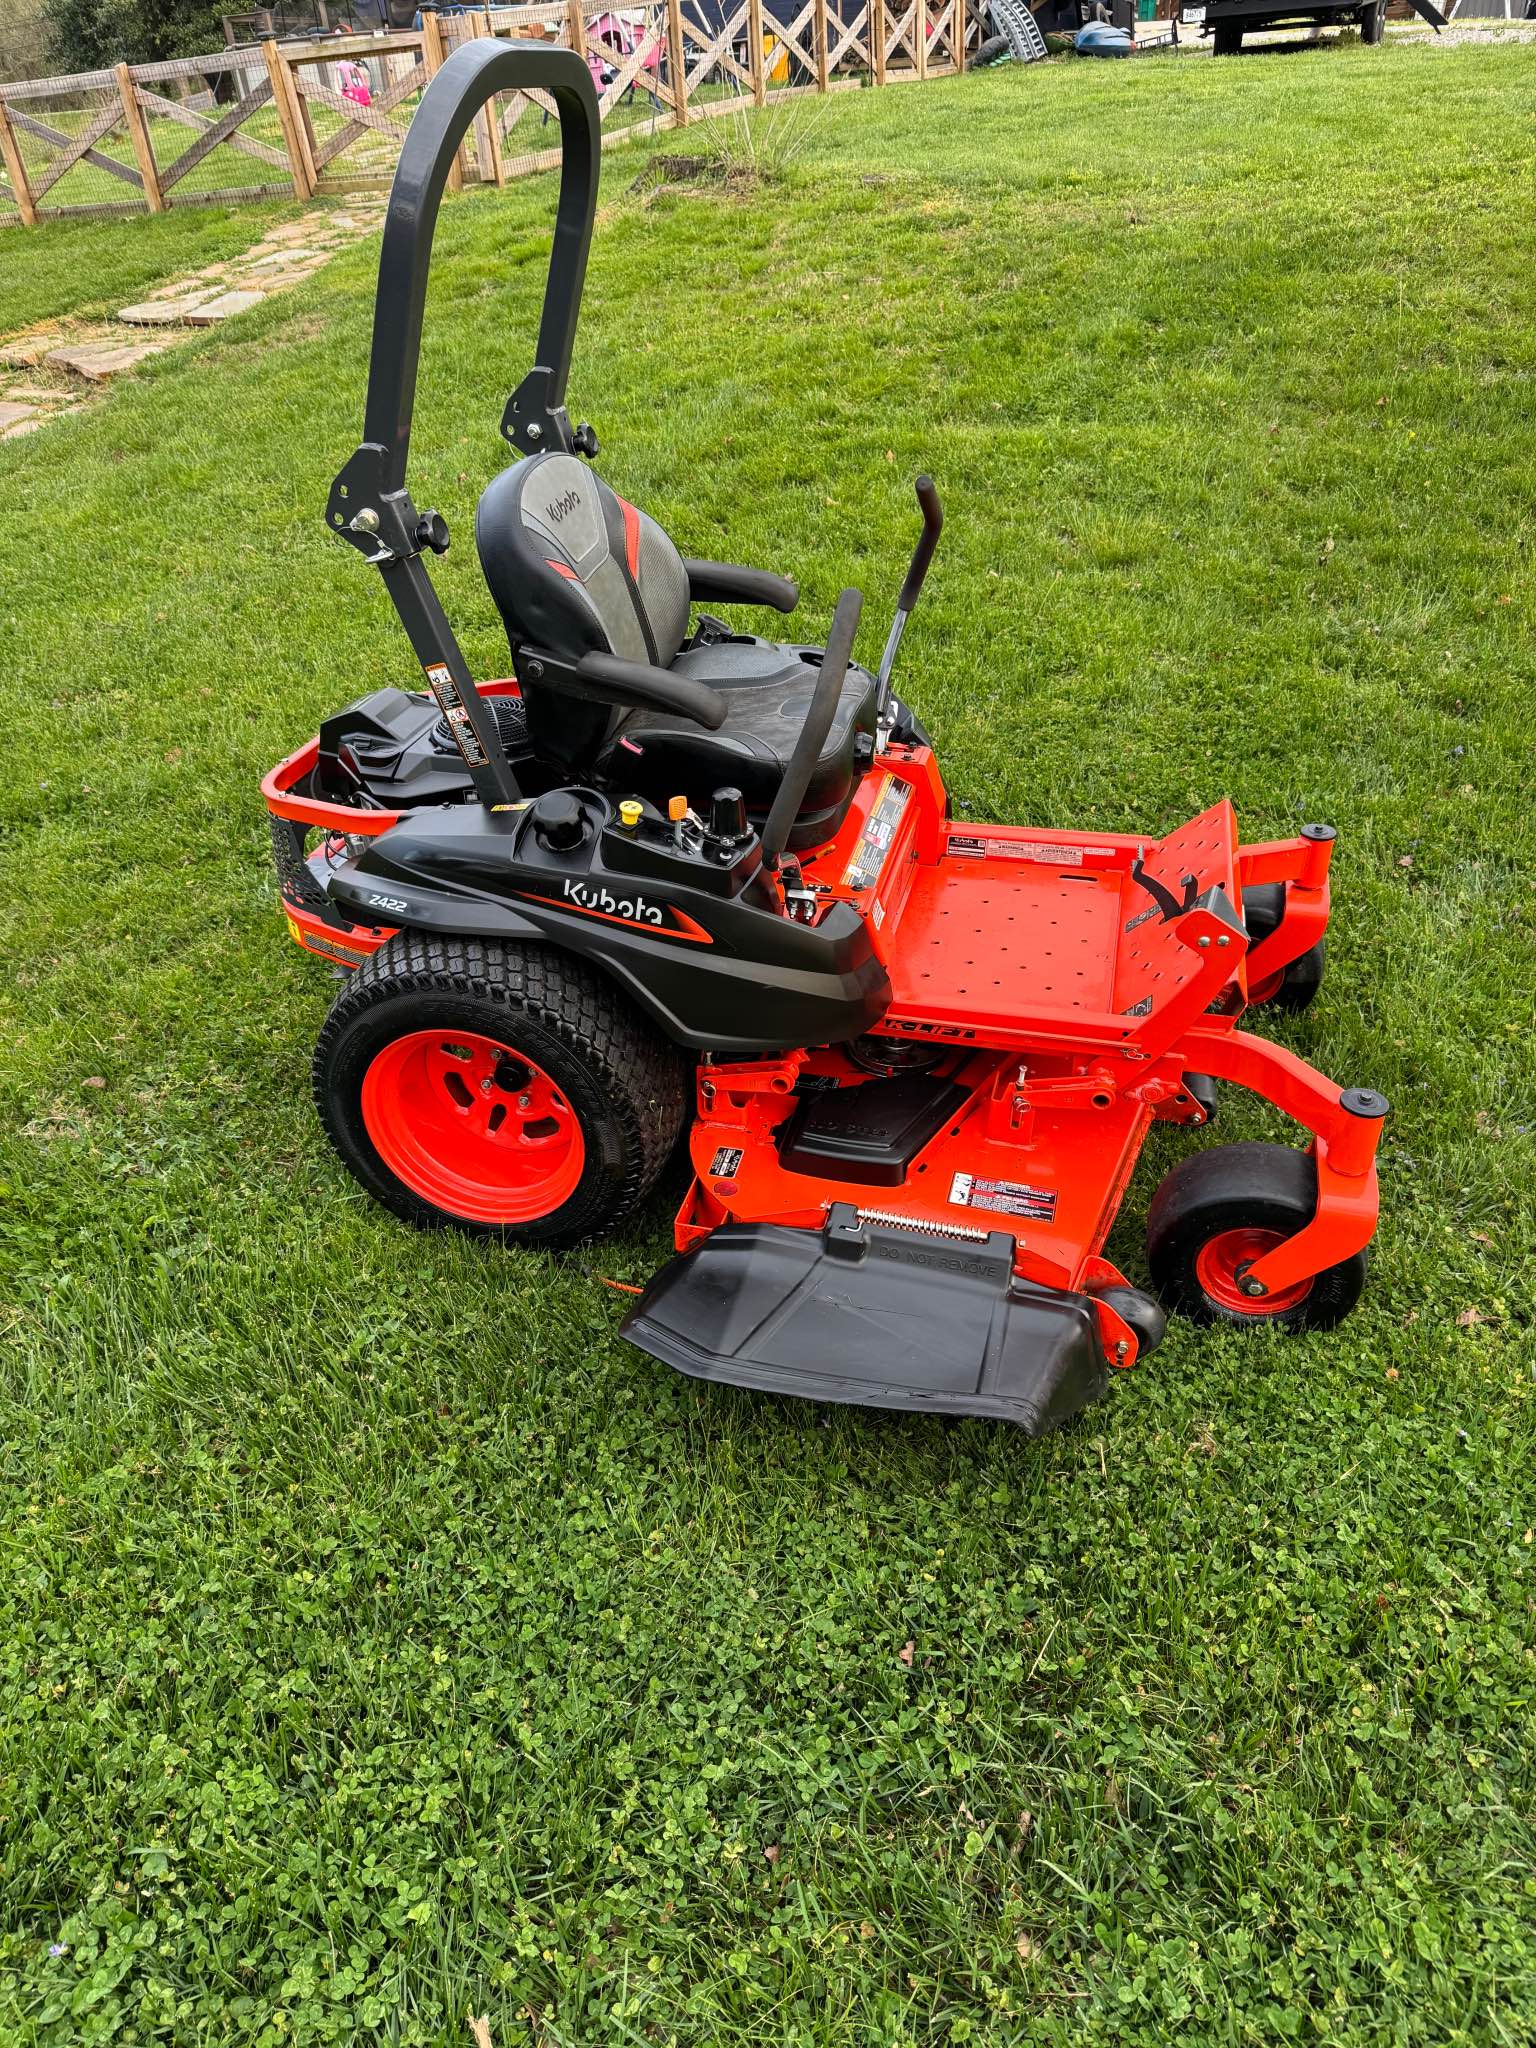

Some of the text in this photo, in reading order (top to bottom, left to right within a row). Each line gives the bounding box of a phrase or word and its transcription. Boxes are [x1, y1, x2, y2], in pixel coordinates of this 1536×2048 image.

[545, 490, 581, 522] Kubota
[369, 894, 408, 912] Z422
[563, 878, 663, 925] Kubota
[887, 1020, 975, 1039] K-LIFT
[880, 1245, 998, 1277] DO NOT REMOVE
